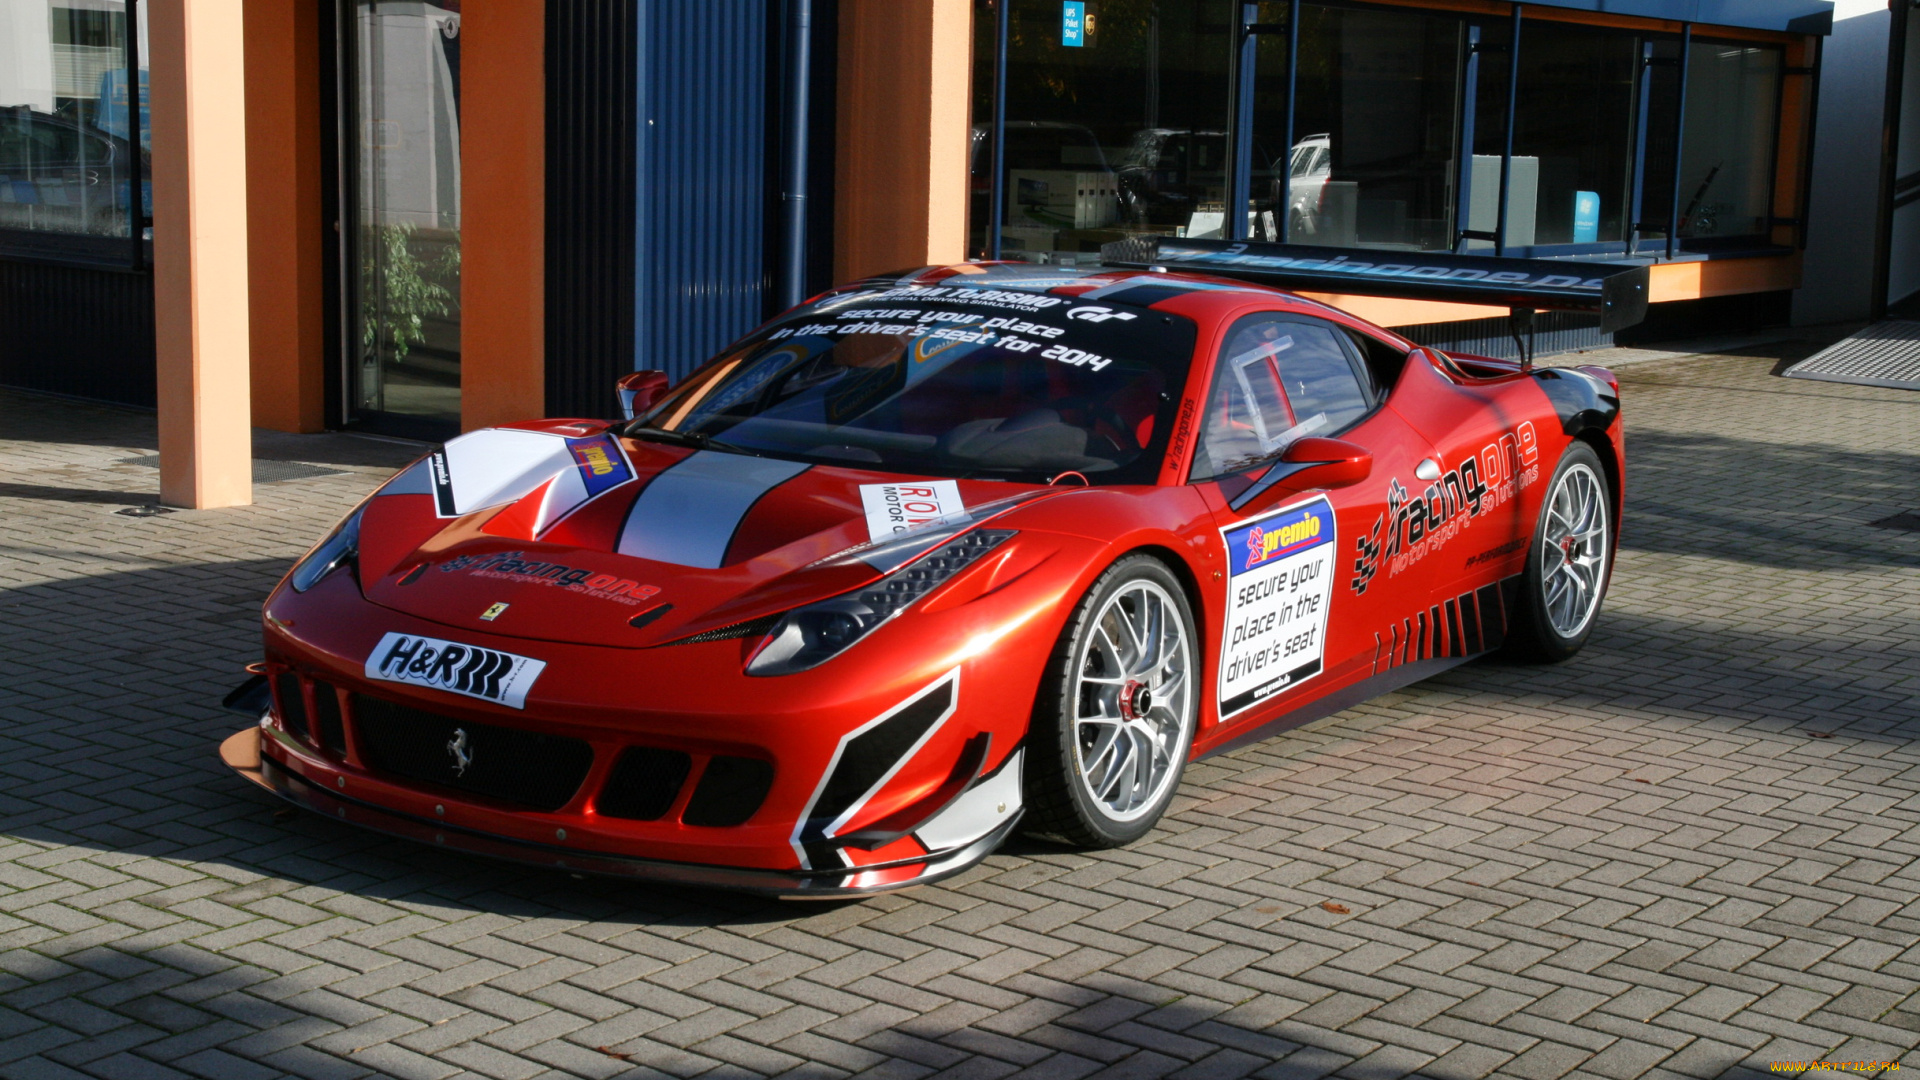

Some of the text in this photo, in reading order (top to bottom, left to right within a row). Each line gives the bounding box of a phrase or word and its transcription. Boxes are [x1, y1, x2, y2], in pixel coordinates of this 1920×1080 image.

[883, 287, 953, 298] GRAN
[921, 296, 969, 304] DRIVING
[969, 299, 1039, 313] SIMULATOR
[793, 323, 839, 337] the
[836, 321, 931, 337] driver's
[928, 328, 996, 345] seat
[993, 335, 1041, 353] for
[1040, 344, 1113, 372] 2014
[836, 308, 1065, 339] secure your place
[580, 446, 618, 476] premio
[882, 486, 904, 522] MOTOR
[1262, 512, 1320, 560] premio
[1388, 510, 1471, 578] Motorsport
[1237, 558, 1324, 609] secure your
[1231, 593, 1321, 653] place in the
[1227, 625, 1317, 684] driver's seat
